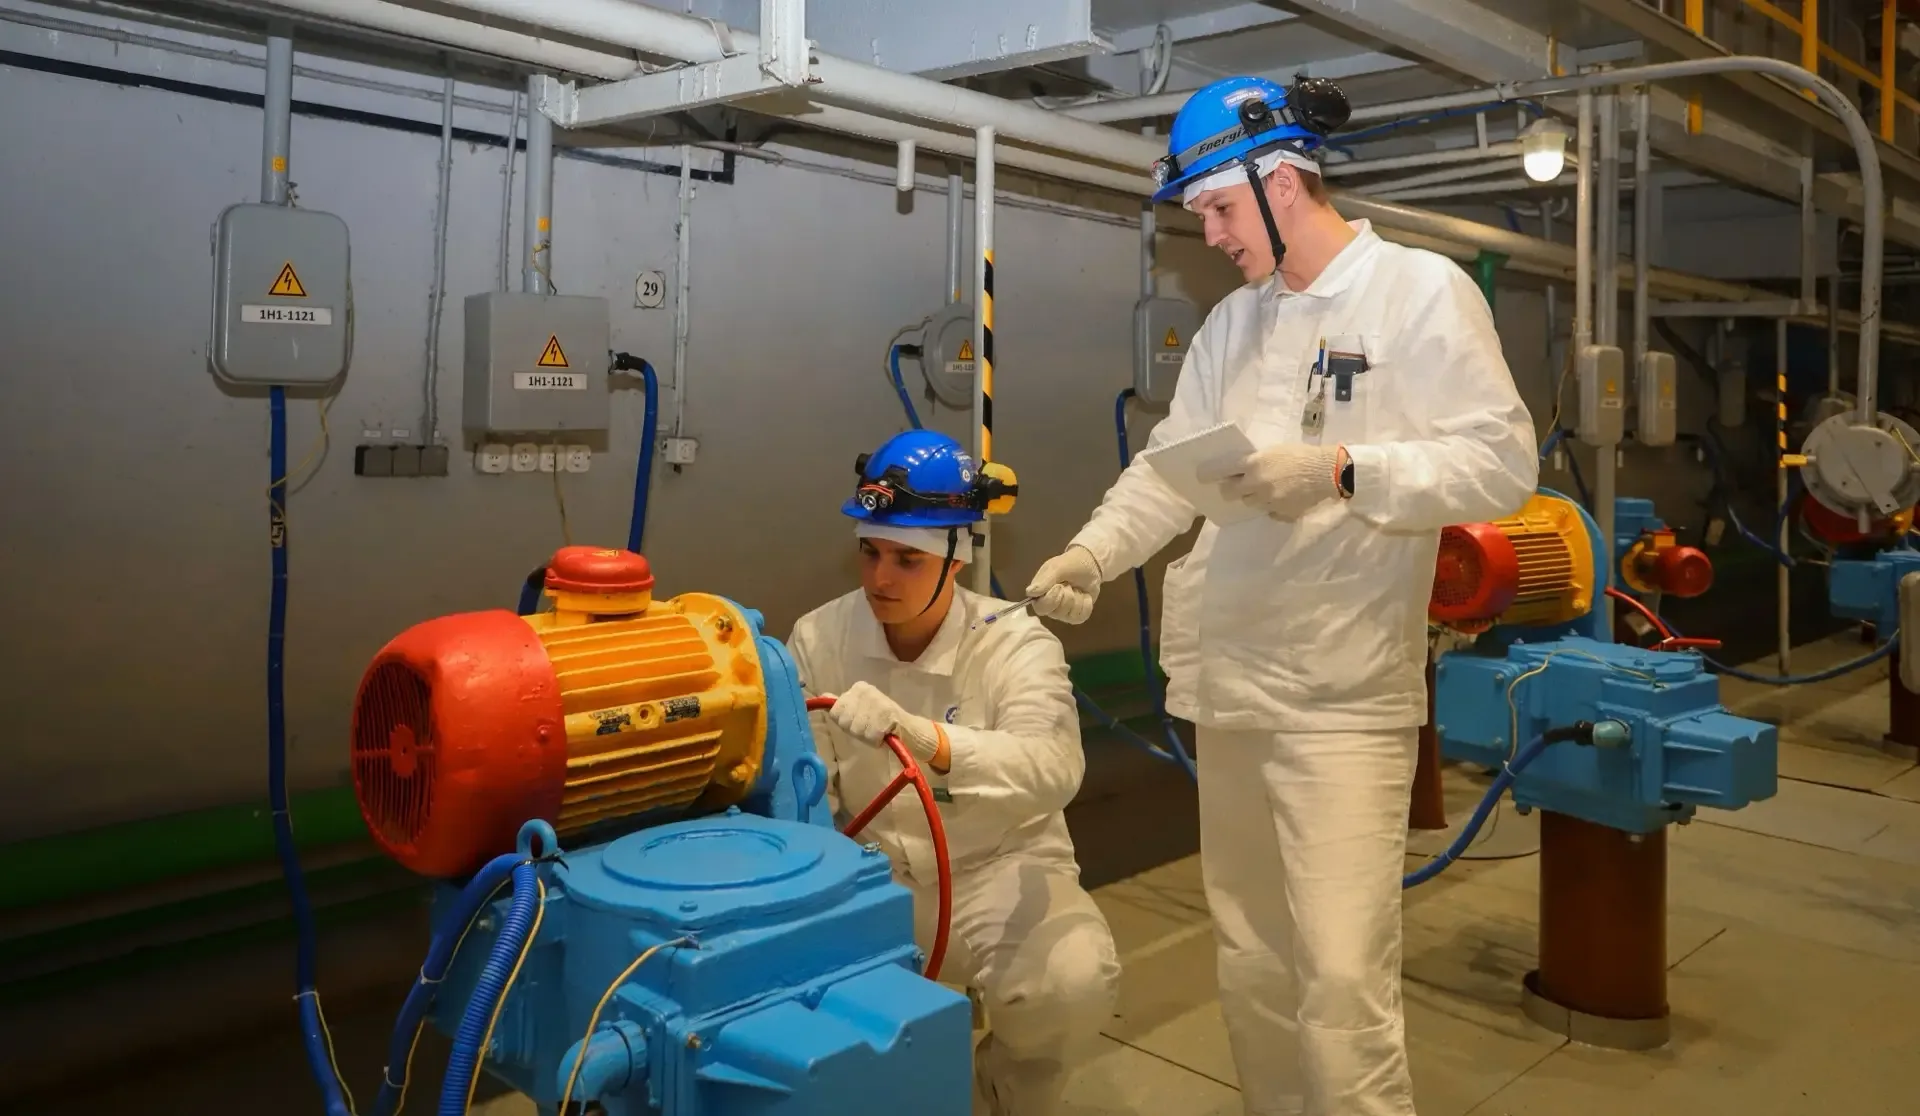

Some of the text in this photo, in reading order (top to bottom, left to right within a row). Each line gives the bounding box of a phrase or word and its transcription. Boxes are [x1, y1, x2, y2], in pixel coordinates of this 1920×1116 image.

[643, 281, 658, 296] 29
[260, 309, 315, 321] 1H1-1121
[529, 376, 573, 387] 1H1-1121
